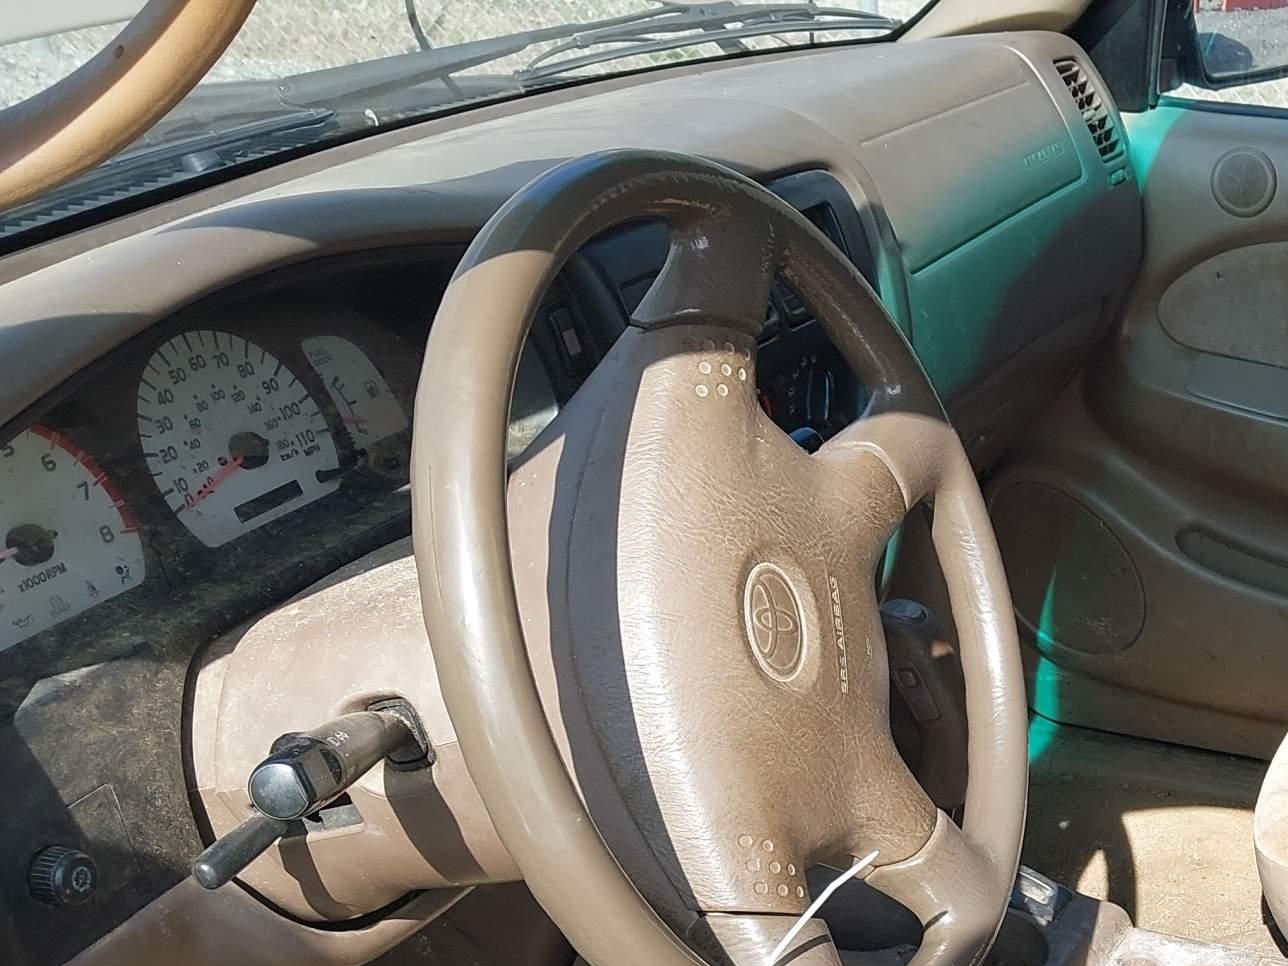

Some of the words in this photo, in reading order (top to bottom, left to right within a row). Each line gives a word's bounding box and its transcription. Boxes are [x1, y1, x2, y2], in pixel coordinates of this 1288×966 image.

[188, 354, 207, 371] 60
[212, 352, 230, 369] 70
[168, 367, 187, 384] 50
[237, 362, 255, 378] 80
[262, 377, 279, 395] 90
[157, 389, 174, 406] 40
[279, 402, 300, 421] 100
[155, 416, 173, 434] 30
[188, 439, 201, 450] 40
[296, 429, 316, 446] 110
[41, 453, 57, 472] 6
[160, 446, 178, 464] 20
[197, 460, 209, 473] 20
[76, 481, 90, 501] 7
[174, 477, 189, 493] 10
[100, 525, 115, 544] 8
[830, 575, 845, 651] AIRBAG
